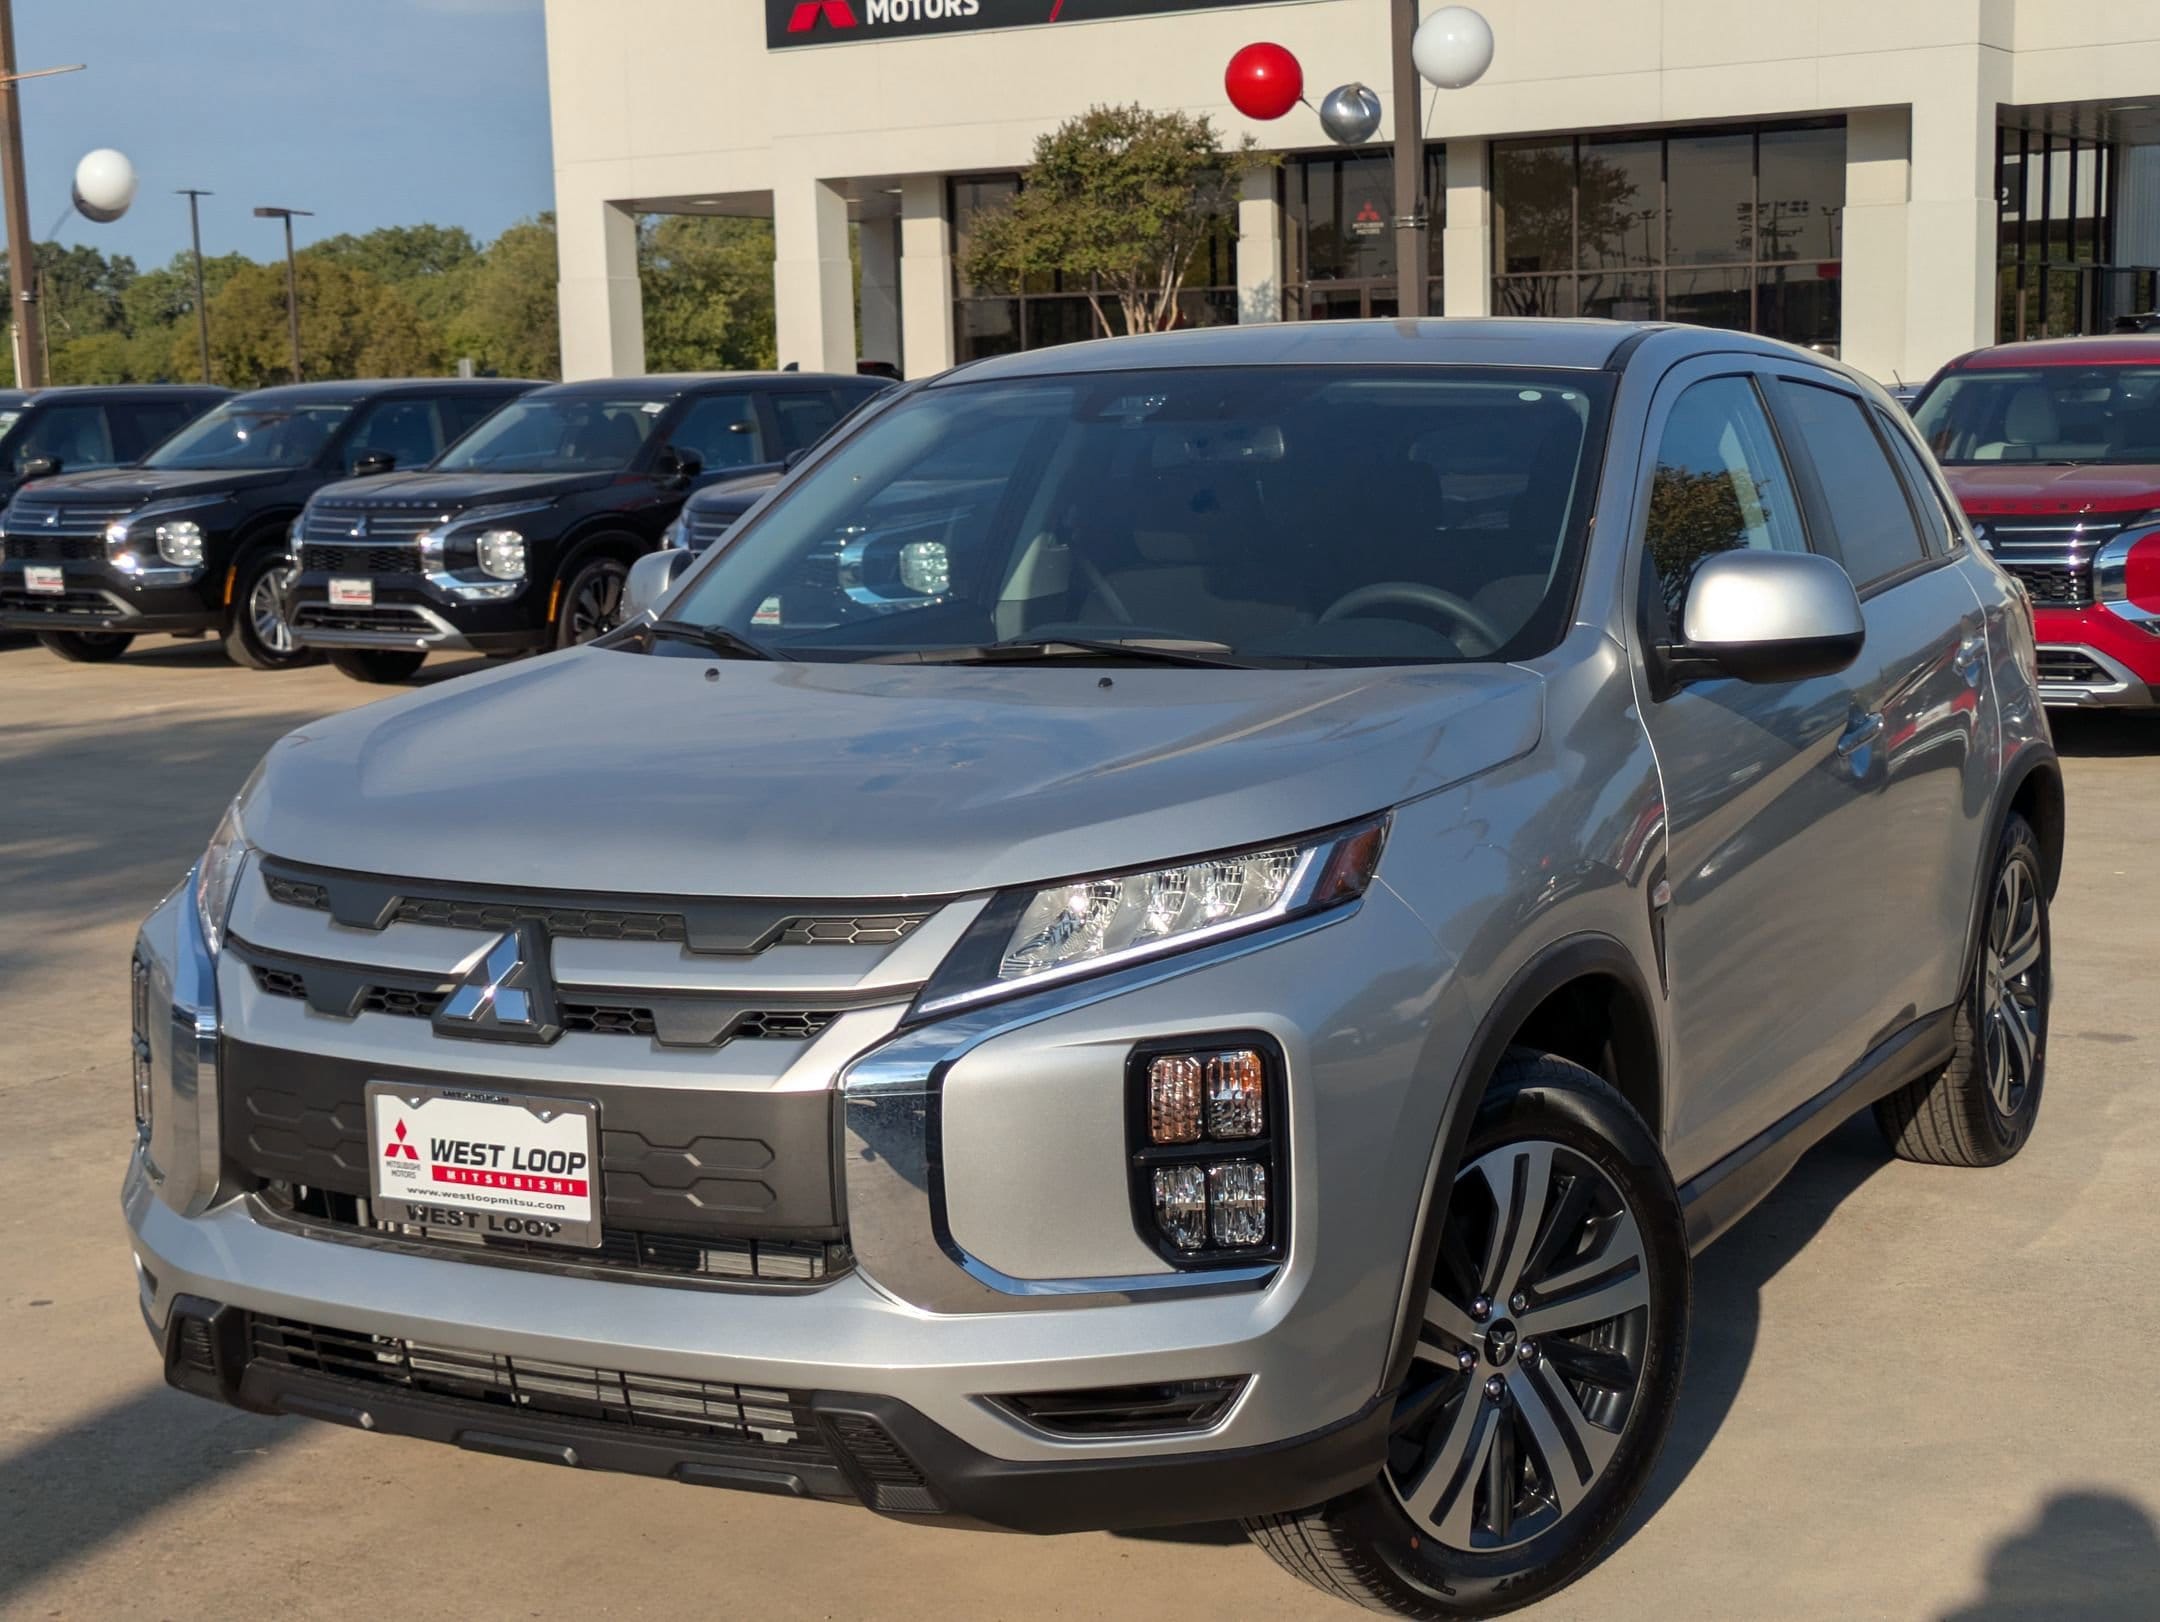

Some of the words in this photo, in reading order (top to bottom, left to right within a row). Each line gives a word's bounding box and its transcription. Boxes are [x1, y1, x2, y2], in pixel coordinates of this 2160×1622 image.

[866, 0, 980, 25] MOTORS
[431, 1138, 505, 1167] WEST
[512, 1147, 586, 1175] LOOP
[446, 1169, 573, 1192] MITSUBISHI
[407, 1186, 565, 1211] www.westloopmitsu.com
[406, 1204, 480, 1228] WEST
[487, 1214, 561, 1237] LOOP
